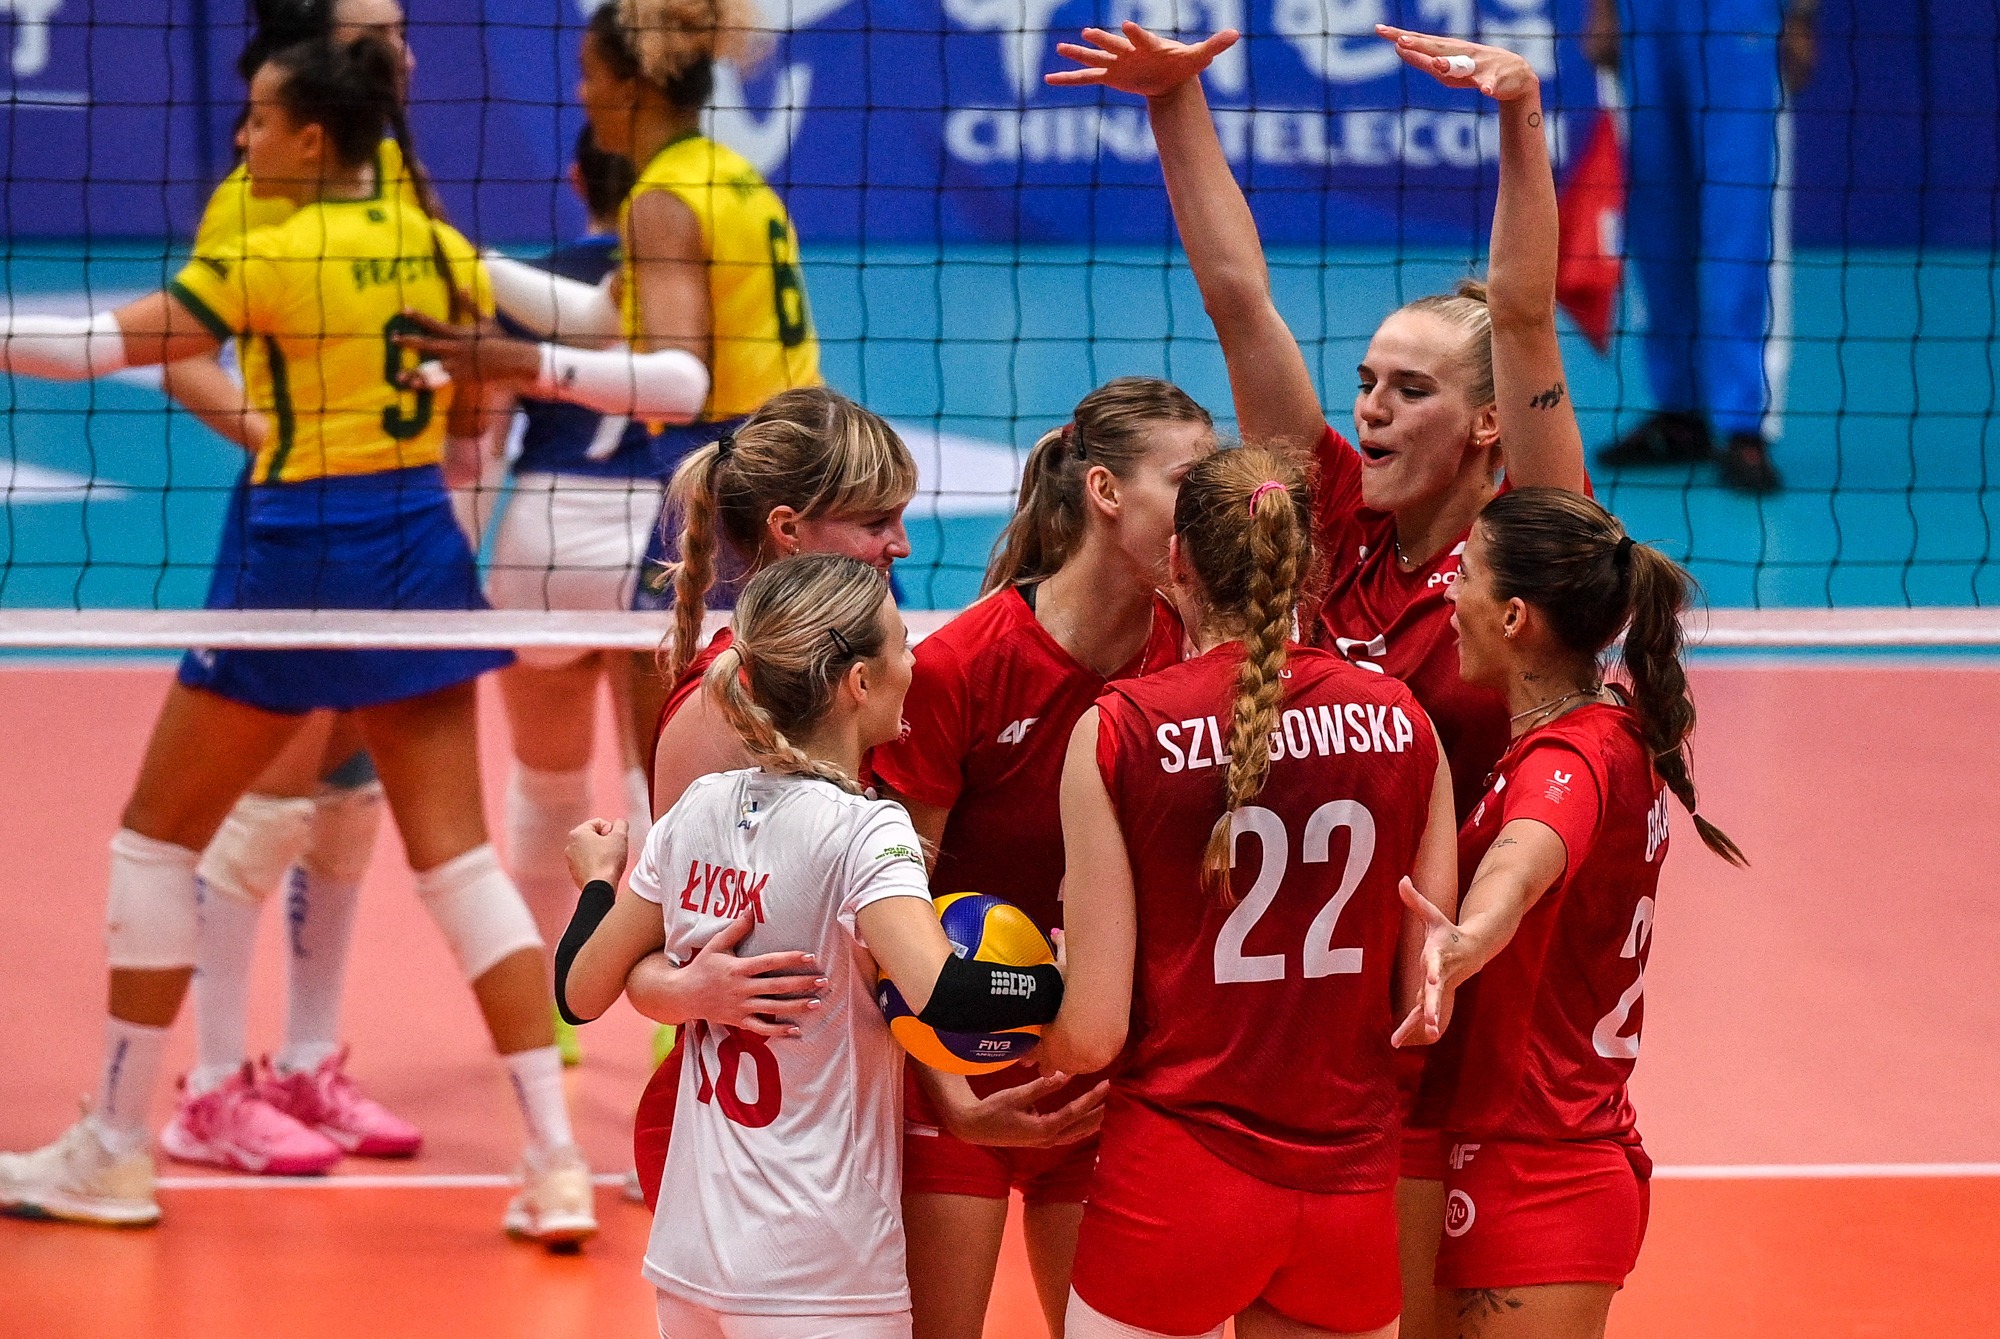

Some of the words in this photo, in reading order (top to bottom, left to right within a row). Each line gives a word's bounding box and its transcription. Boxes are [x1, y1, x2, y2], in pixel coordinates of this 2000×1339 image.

[945, 107, 1157, 163] CHIN
[769, 218, 806, 347] 6
[382, 313, 438, 440] 9
[1156, 703, 1413, 774] SZLGOWSKA
[1213, 799, 1376, 985] 22
